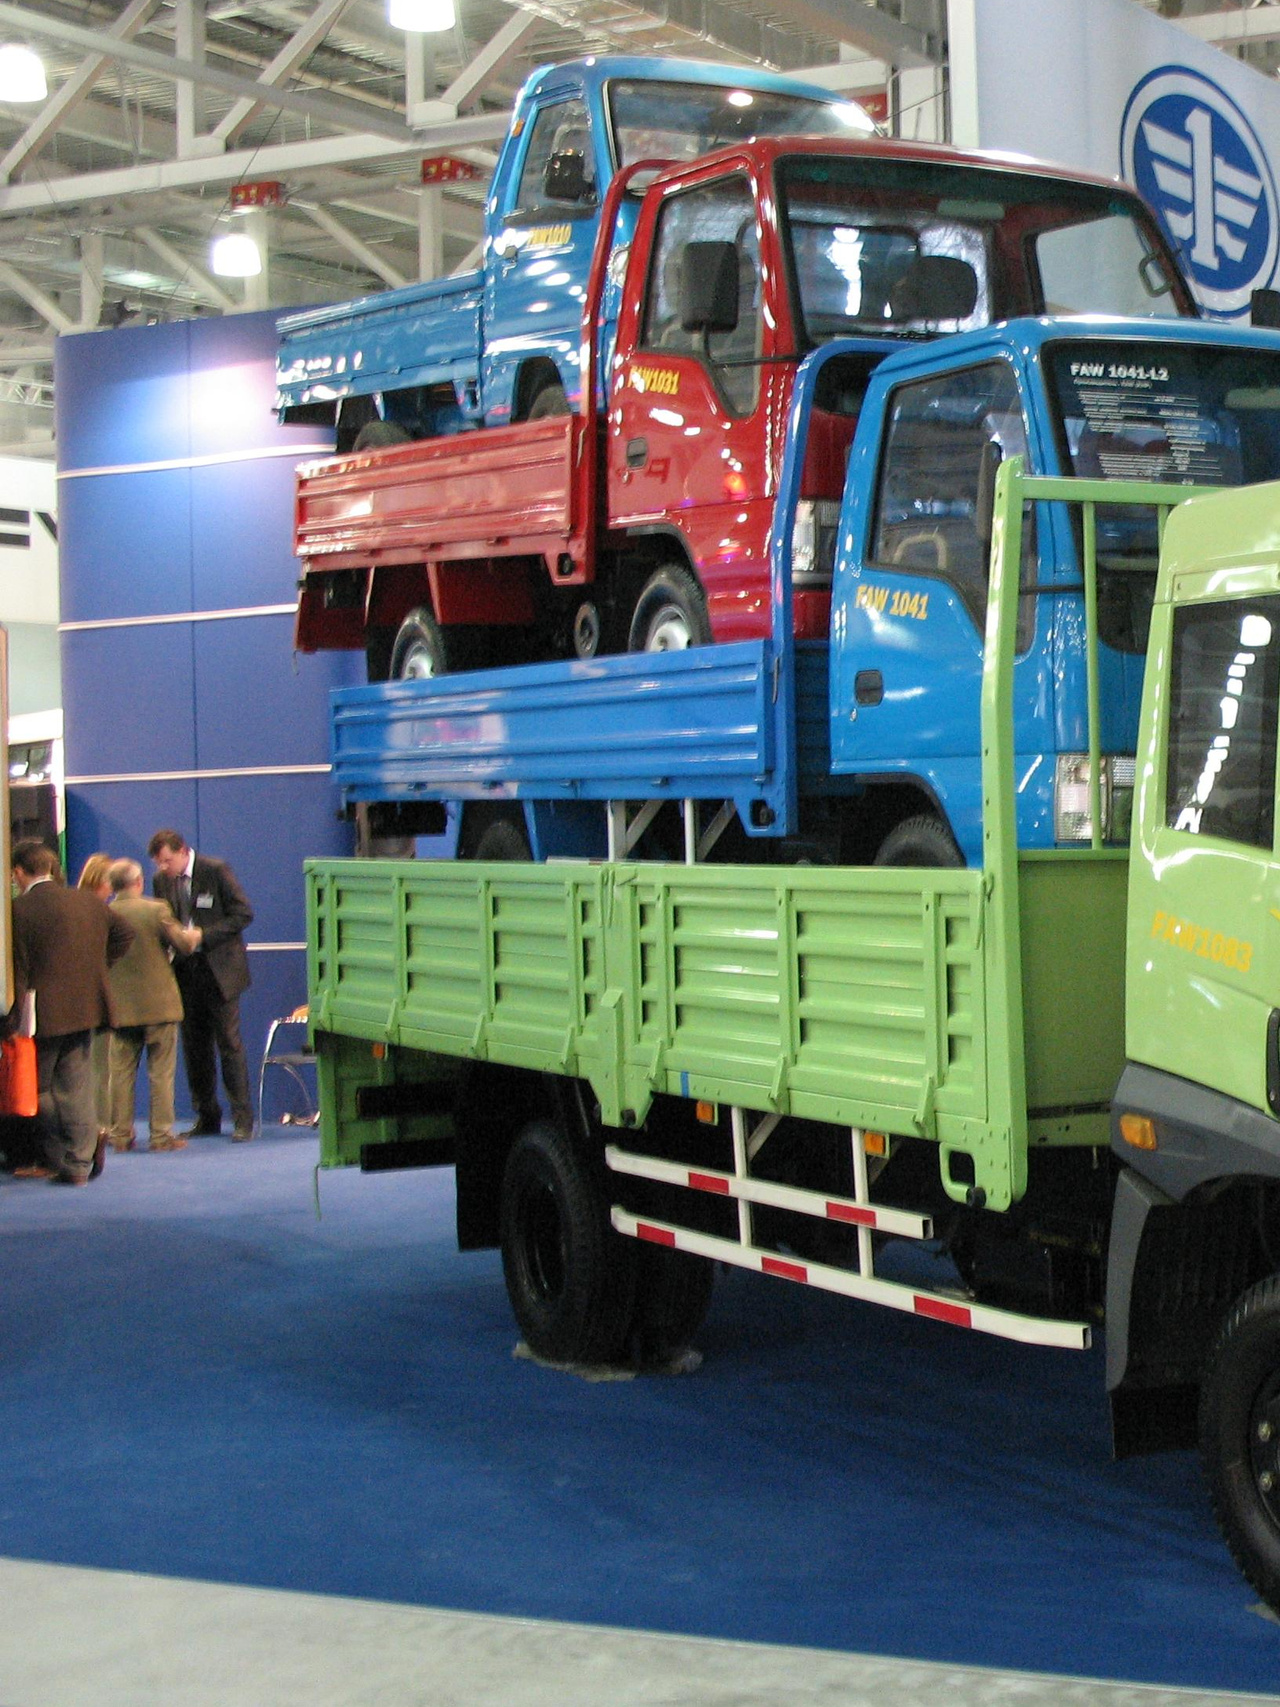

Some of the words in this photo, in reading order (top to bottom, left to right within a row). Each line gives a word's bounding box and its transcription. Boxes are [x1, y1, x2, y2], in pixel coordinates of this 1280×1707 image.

[1071, 362, 1104, 377] FAW
[855, 584, 890, 612] FAW
[889, 590, 929, 620] 1041
[1150, 909, 1254, 973] FAW1083
